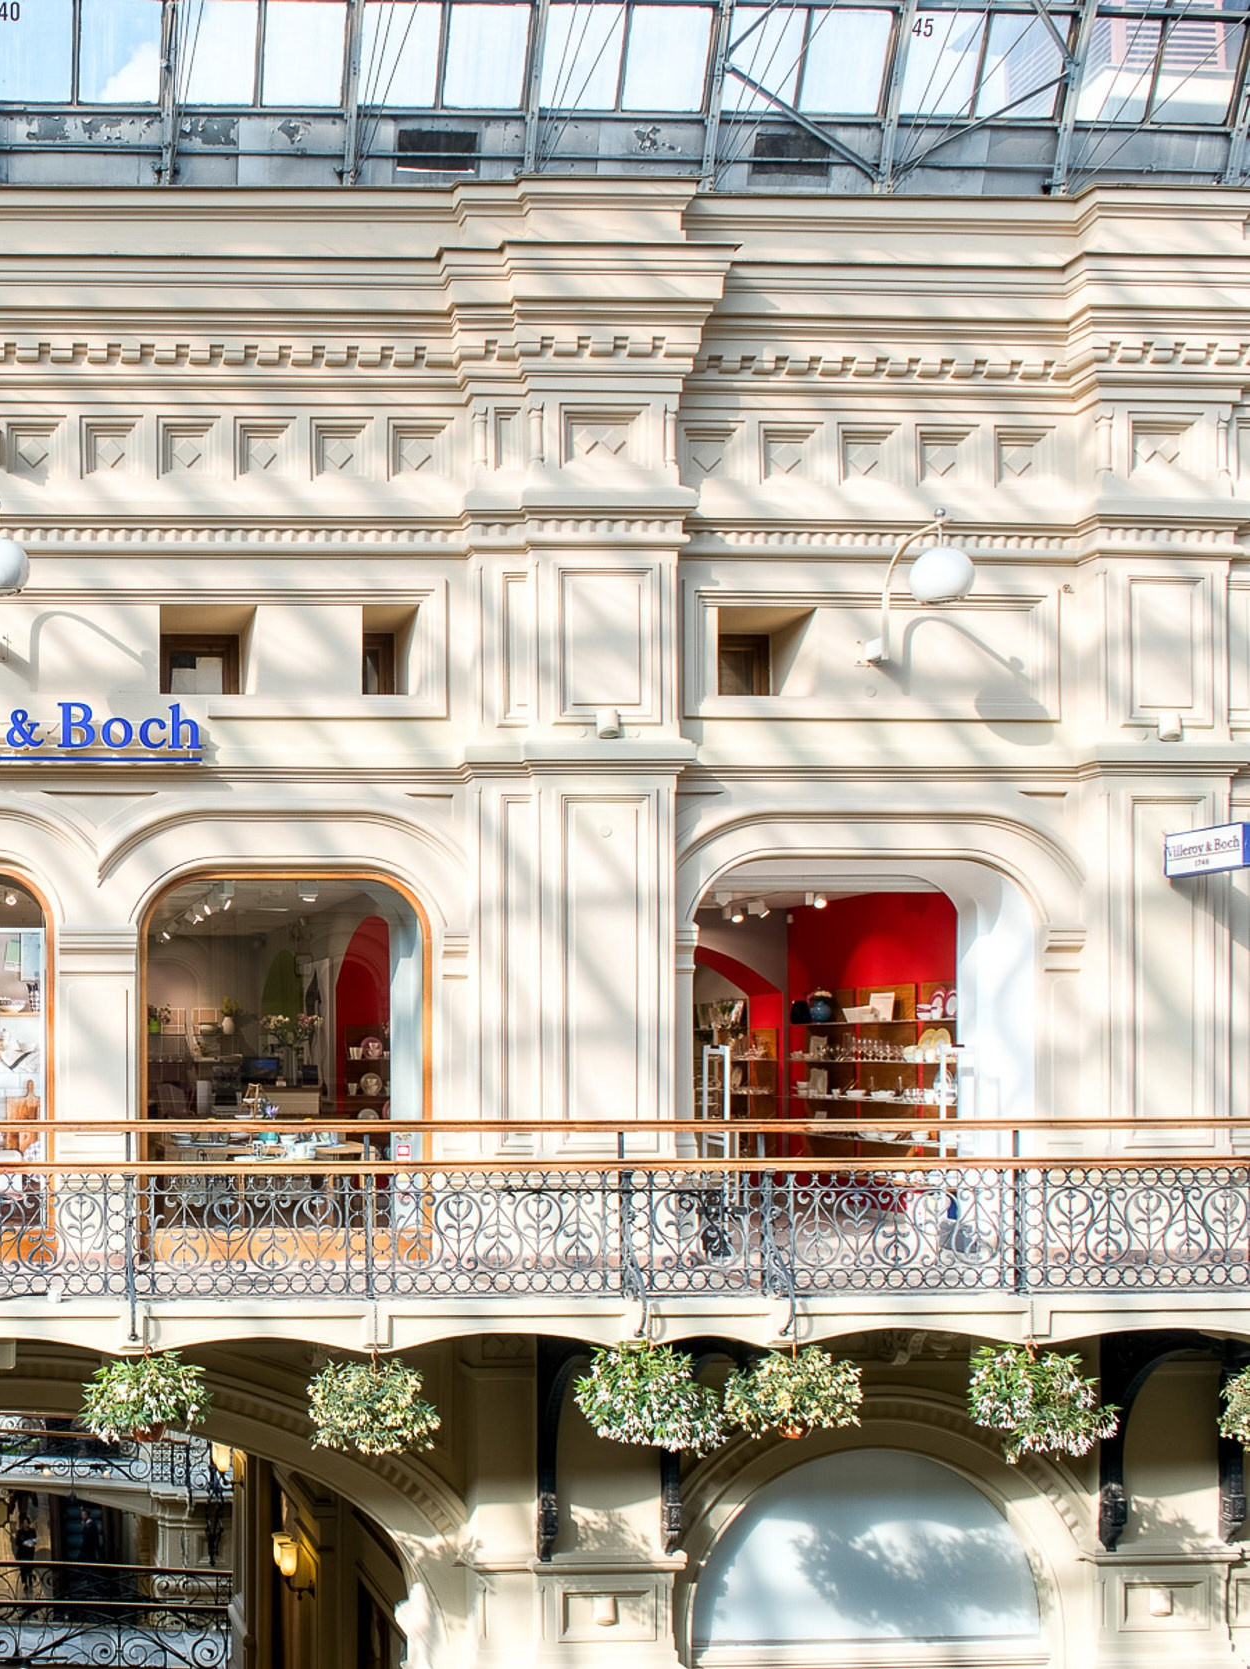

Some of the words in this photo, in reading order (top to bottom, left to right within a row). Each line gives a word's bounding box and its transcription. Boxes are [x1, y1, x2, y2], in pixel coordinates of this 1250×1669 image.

[912, 17, 934, 37] 45
[5, 709, 44, 748] &
[57, 702, 203, 750] Boch
[1166, 843, 1204, 858] Villeroy
[1205, 841, 1212, 852] &
[1214, 835, 1240, 850] Boch
